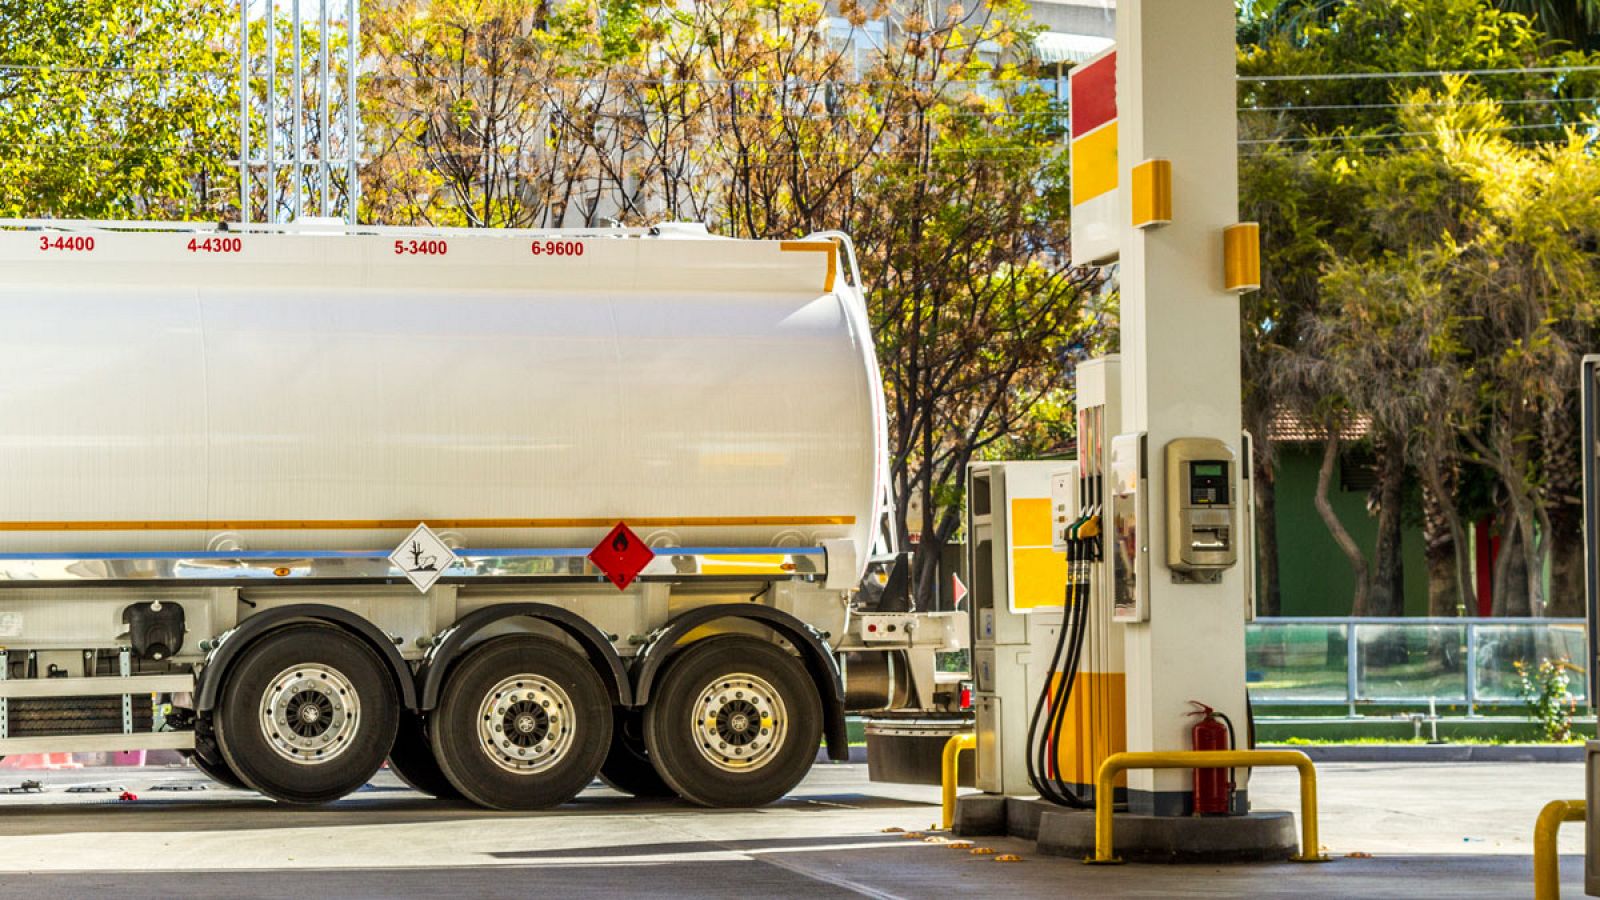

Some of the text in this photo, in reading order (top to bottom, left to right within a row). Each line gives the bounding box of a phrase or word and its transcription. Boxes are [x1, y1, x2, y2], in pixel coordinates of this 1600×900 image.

[39, 236, 95, 251] 3-4400
[186, 238, 242, 253] 4-4300
[394, 240, 448, 255] 5-3400
[531, 241, 584, 256] 6-9600
[617, 573, 625, 583] 3
